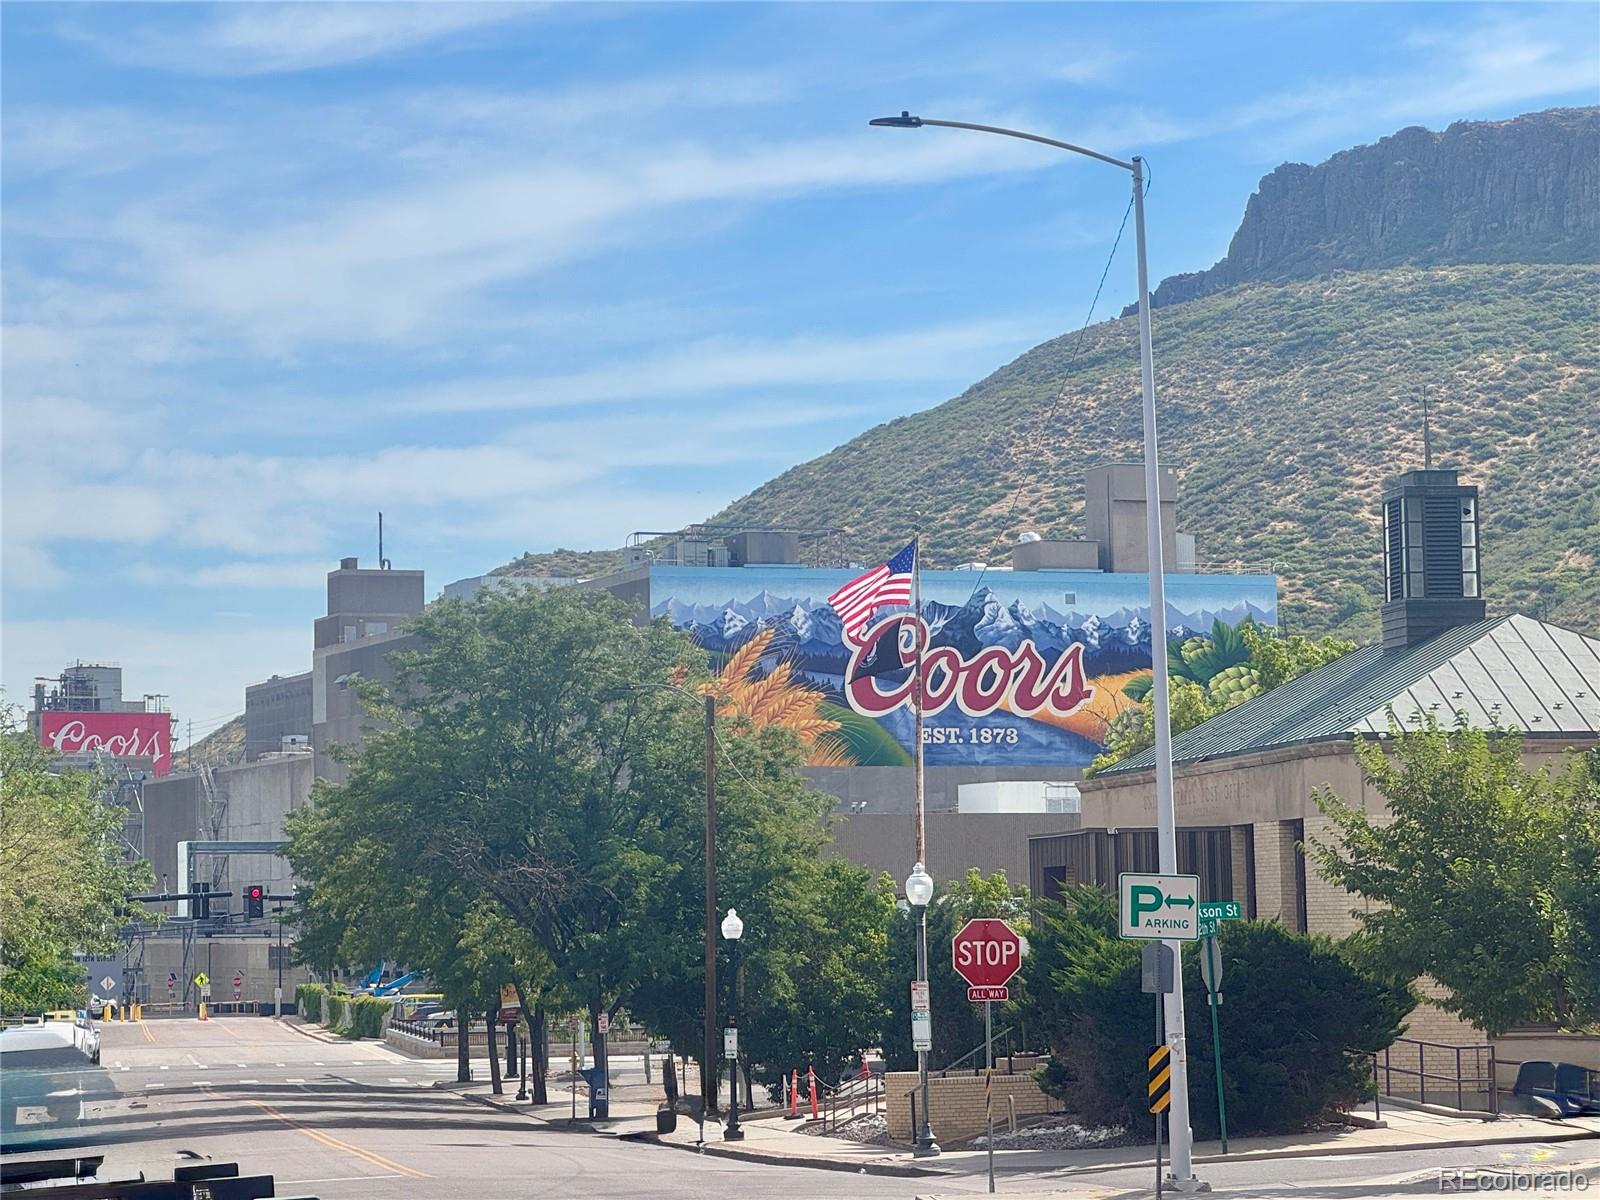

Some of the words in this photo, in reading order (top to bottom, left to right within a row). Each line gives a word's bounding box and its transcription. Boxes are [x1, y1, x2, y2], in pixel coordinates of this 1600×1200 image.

[843, 615, 1094, 717] Coors
[922, 728, 964, 744] EST.
[969, 728, 1019, 744] 1873
[1199, 907, 1222, 918] kson
[1226, 904, 1238, 917] St
[1209, 920, 1216, 934] St
[958, 940, 1016, 966] STOP
[972, 990, 986, 999] ALL
[988, 989, 1004, 998] WAY
